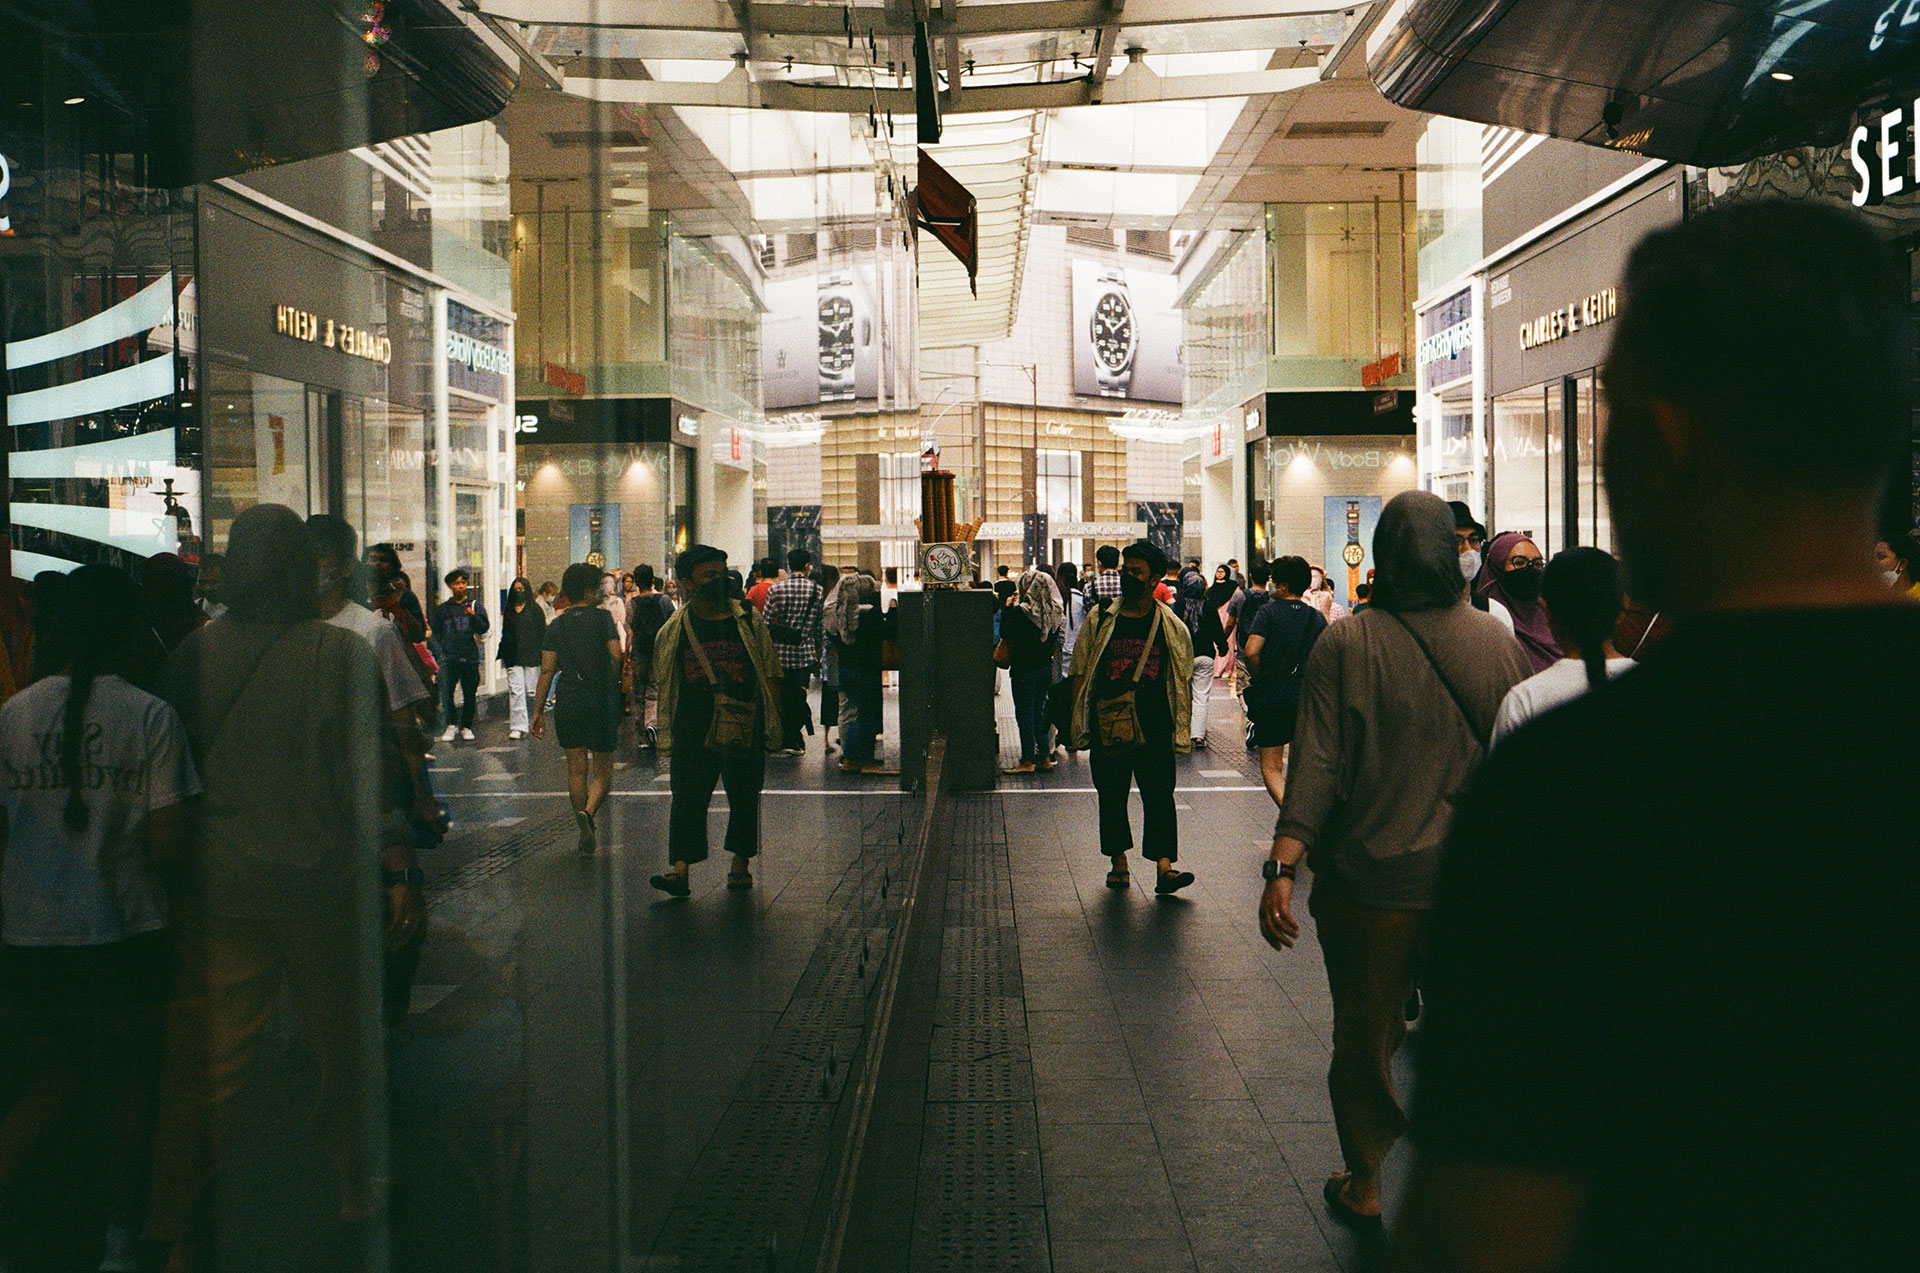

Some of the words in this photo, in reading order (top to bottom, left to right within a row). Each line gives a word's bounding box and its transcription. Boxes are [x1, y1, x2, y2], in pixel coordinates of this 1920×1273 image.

[1520, 308, 1564, 350] CHARLES
[1568, 303, 1578, 333] &
[1583, 286, 1616, 327] KEITH
[1045, 418, 1075, 436] Cartier
